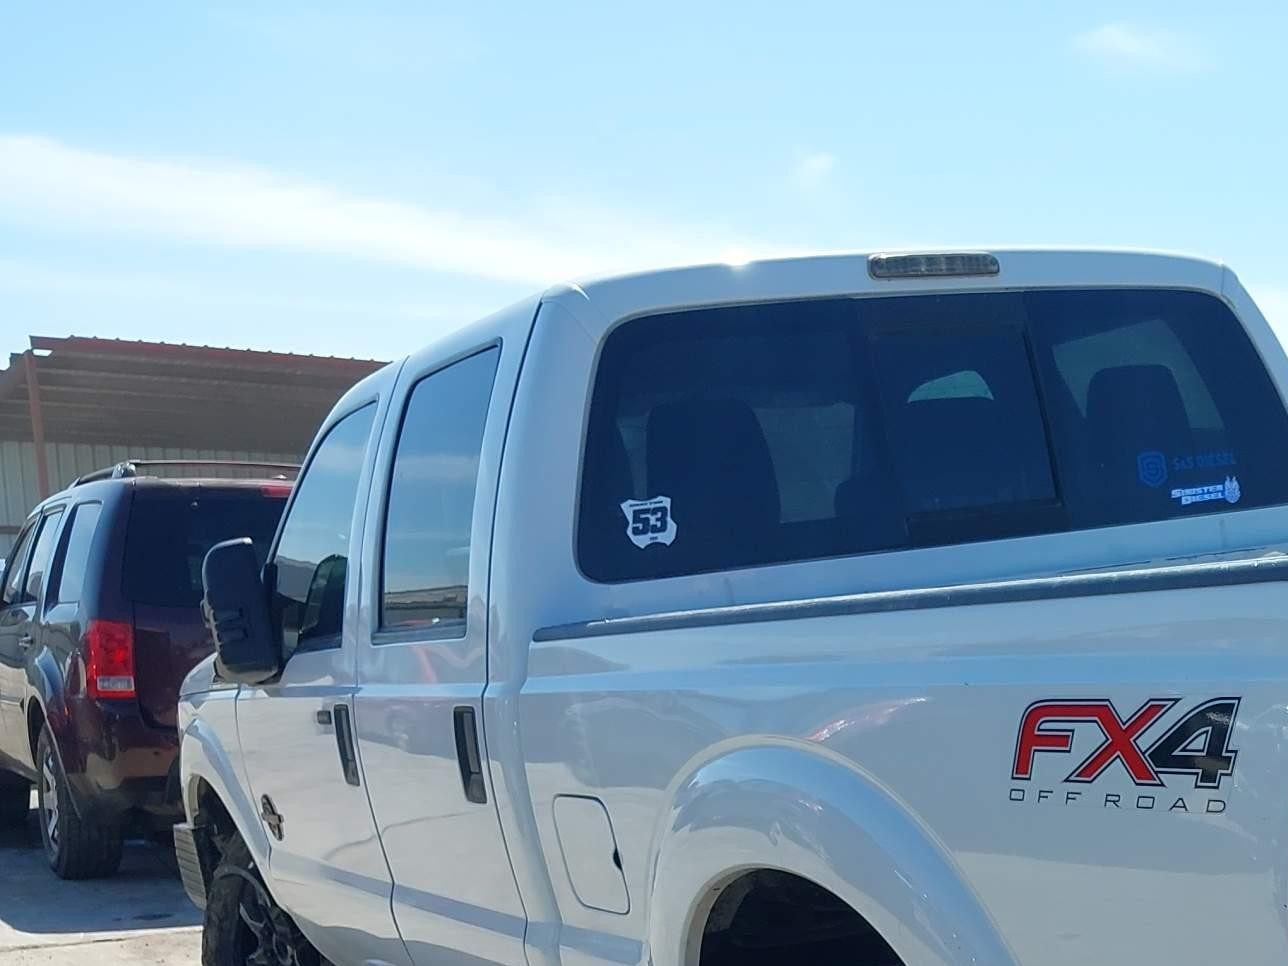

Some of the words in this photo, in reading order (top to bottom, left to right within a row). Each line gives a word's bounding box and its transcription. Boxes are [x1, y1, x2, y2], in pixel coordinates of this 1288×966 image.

[1182, 492, 1224, 504] DIESEL
[632, 506, 668, 536] 53
[1011, 696, 1242, 790] FX4
